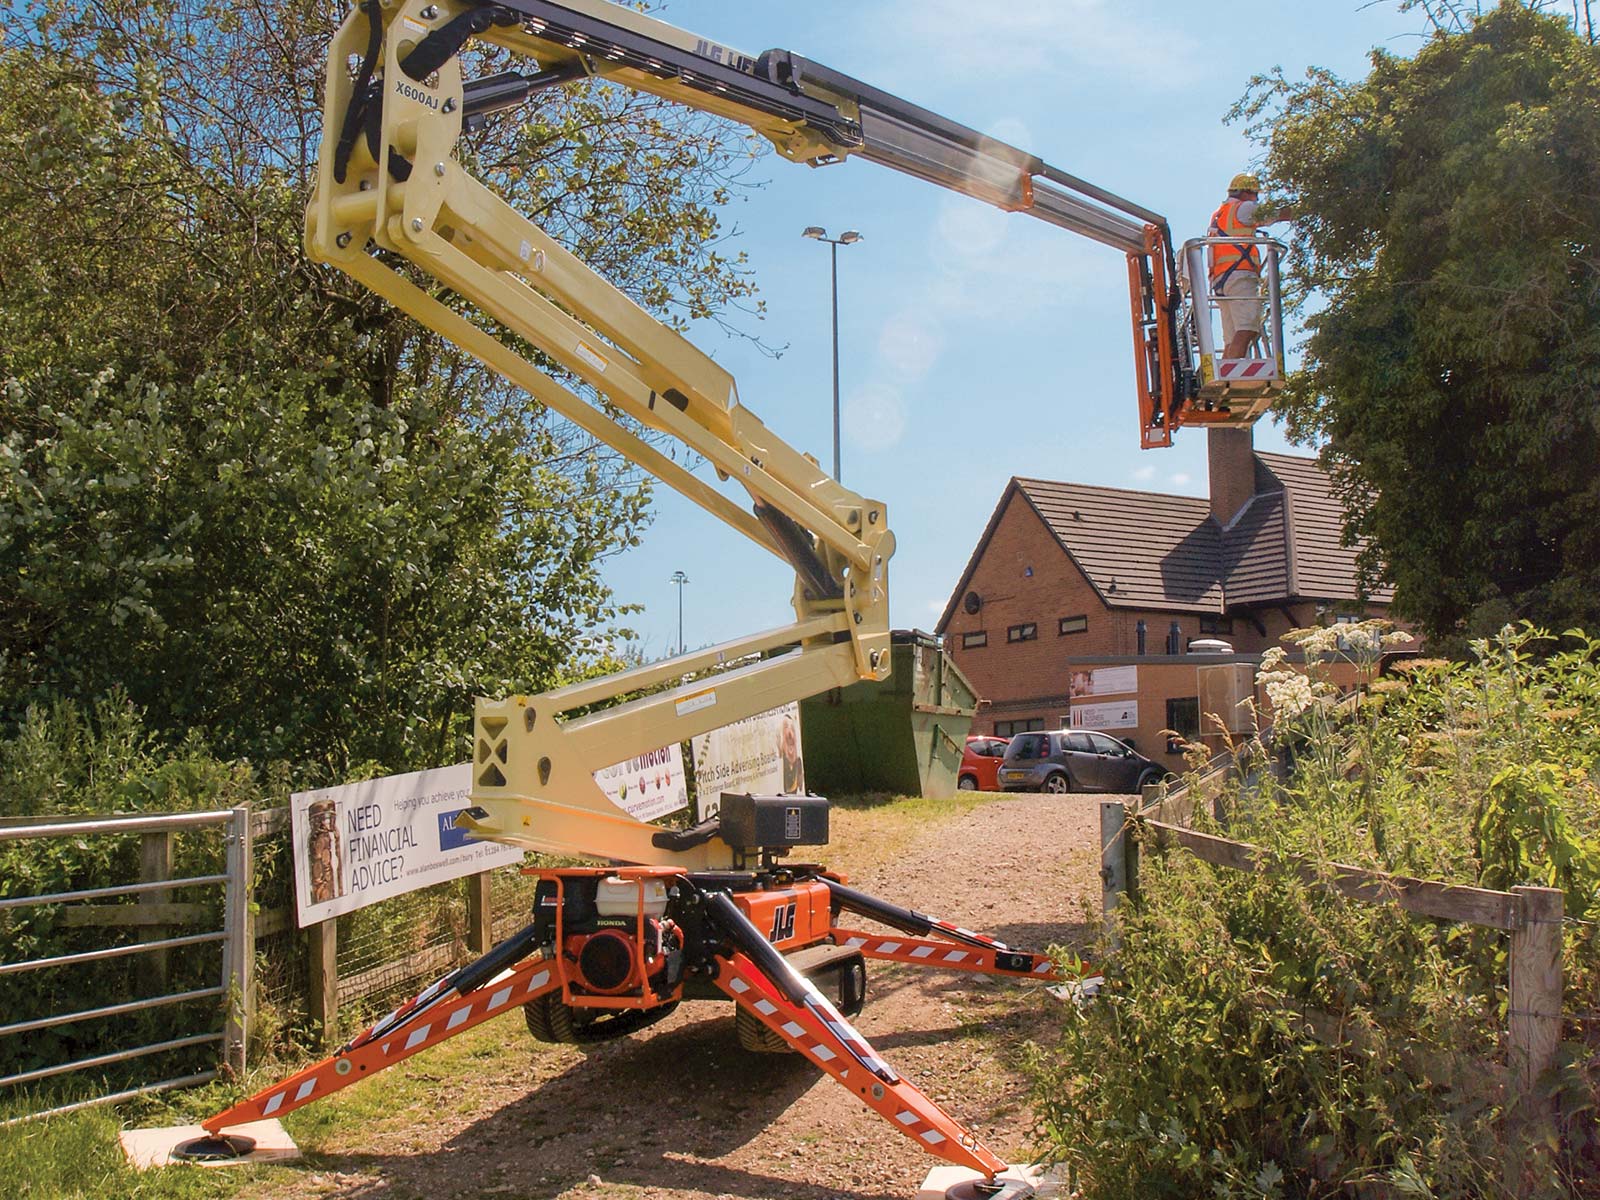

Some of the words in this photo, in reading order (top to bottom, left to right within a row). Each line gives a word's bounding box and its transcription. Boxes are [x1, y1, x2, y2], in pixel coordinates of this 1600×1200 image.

[693, 39, 723, 61] JLG
[395, 80, 439, 110] X600AJ
[716, 762, 730, 779] Side
[394, 798, 417, 812] Helping
[417, 797, 430, 809] you
[431, 792, 455, 804] achieve
[348, 804, 382, 834] NEED
[349, 825, 418, 865] FINANCIAL
[352, 855, 405, 893] ADVICE?
[769, 902, 796, 944] JLG
